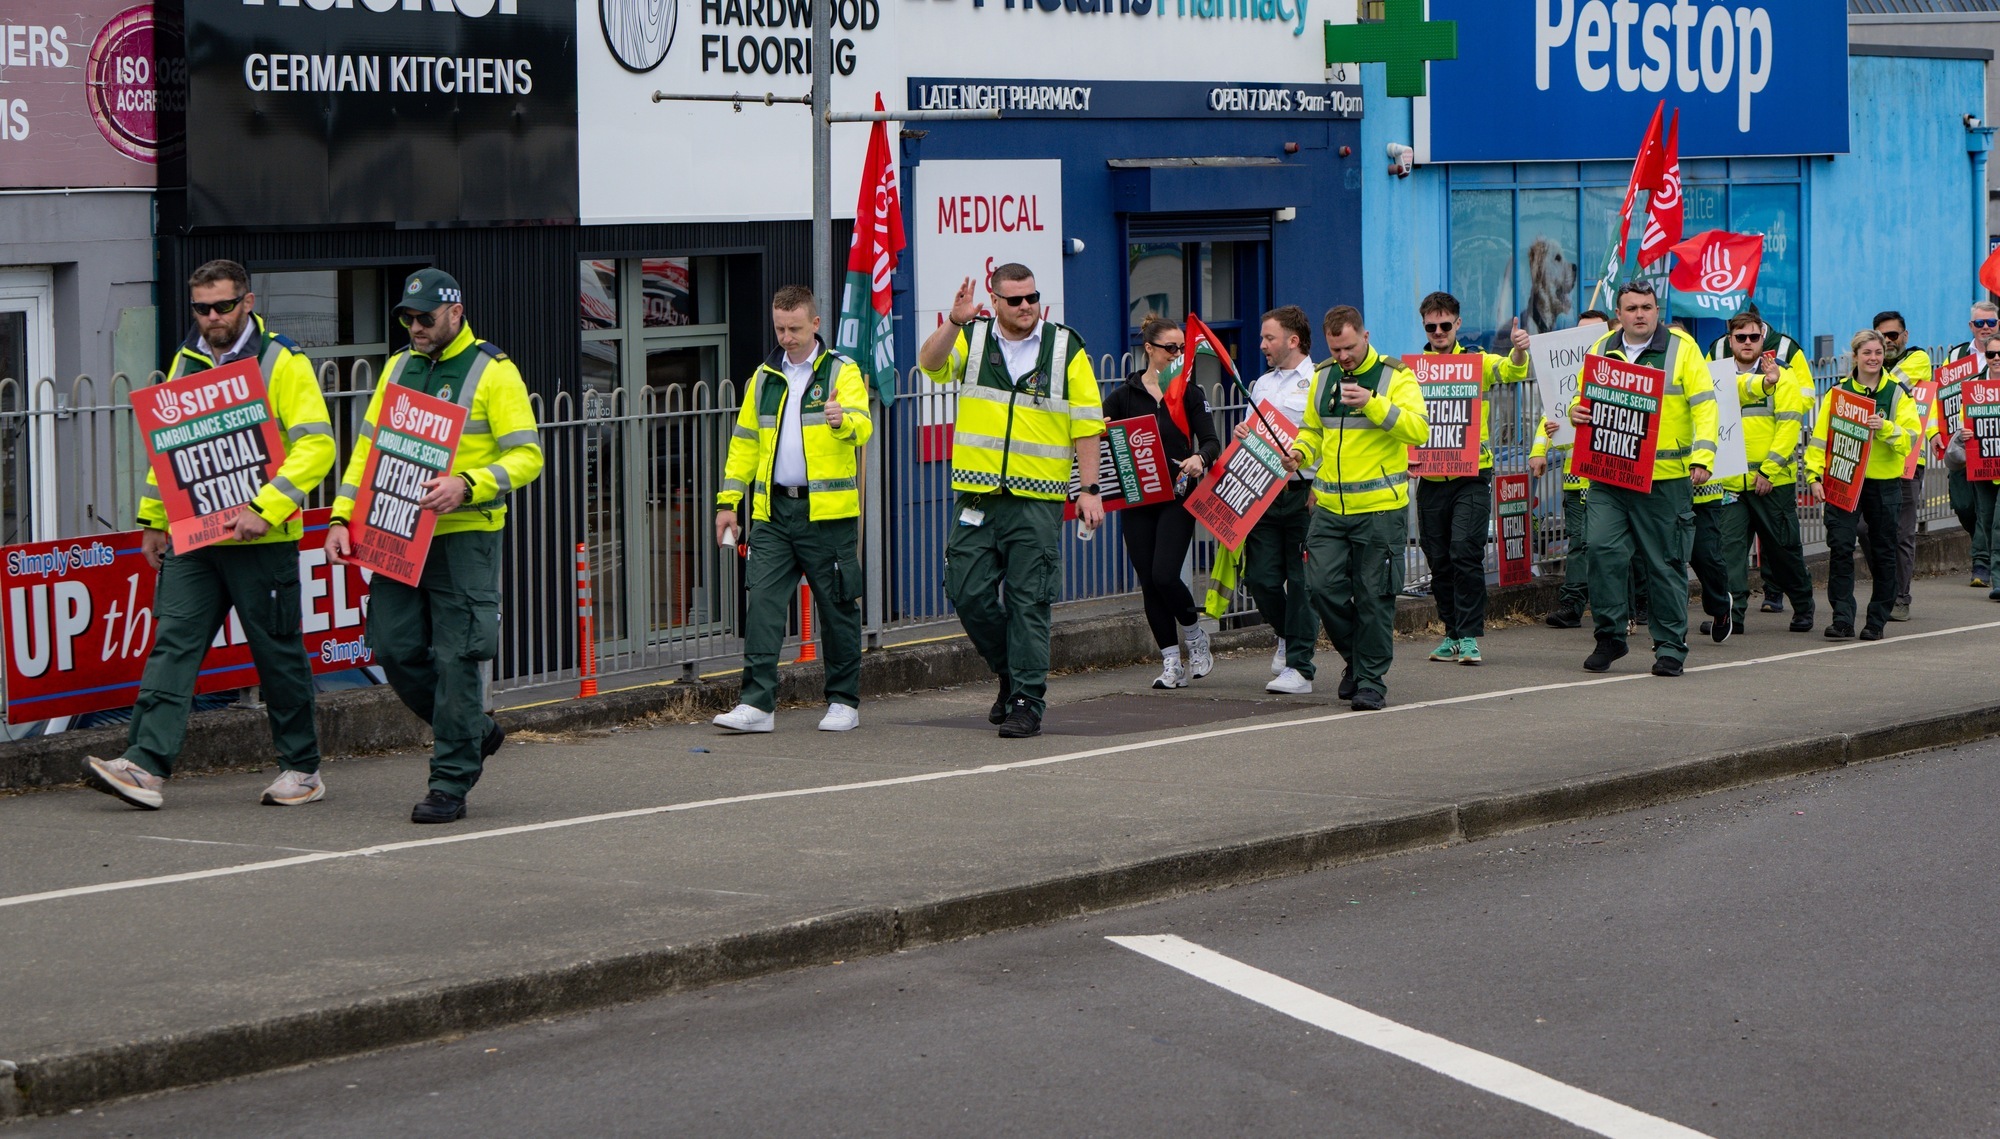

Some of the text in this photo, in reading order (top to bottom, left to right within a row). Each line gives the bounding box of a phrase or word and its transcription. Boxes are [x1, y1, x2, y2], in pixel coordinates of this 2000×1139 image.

[701, 0, 880, 30] HARDWOD
[0, 25, 69, 68] ERS
[702, 34, 857, 76] FLOORIG
[117, 56, 149, 84] ISO
[244, 53, 533, 95] GERMAN KITCHENS
[1535, 0, 1773, 133] Petstop
[919, 85, 1092, 110] LATE NIGHT PHARMACY
[1211, 88, 1249, 111] OPEN
[1249, 90, 1258, 110] 7
[1259, 90, 1291, 111] DAYS
[938, 195, 1044, 234] MEDICAL
[1550, 344, 1592, 369] HONK
[1949, 361, 1973, 380] SIPTU
[1430, 363, 1473, 380] SIPTU
[1559, 373, 1577, 395] FO
[1610, 368, 1653, 394] SIPTU
[180, 375, 249, 416] SIPTU
[1420, 385, 1478, 397] ULANCE SECTOR
[1586, 385, 1657, 412] AMBULANCE SECTOR
[405, 406, 453, 443] SIPTU
[1424, 399, 1468, 423] FICIAL
[1592, 402, 1645, 436] OFFICIAL
[1844, 403, 1868, 424] SIPTU
[154, 404, 267, 450] AMBULANCE SECTOR
[1419, 424, 1463, 448] TRIKE
[376, 430, 450, 467] AMBULANCE SECTOR
[1418, 450, 1462, 462] HSE NATIONAL
[1593, 427, 1638, 459] STRIKE
[1832, 432, 1862, 463] OFFICIAL
[174, 430, 265, 485] OFFICIAL
[1110, 428, 1140, 503] AMBULANCE SECTOR
[1135, 447, 1162, 493] SIPTU
[1449, 461, 1473, 472] SERVICE
[1591, 453, 1635, 473] HSE NATIONAL
[1829, 456, 1856, 483] STRIKE
[1228, 447, 1274, 497] OFFICIAL
[1579, 462, 1645, 487] AMBULANCE SERVICE
[194, 466, 261, 516] STRIKE
[1215, 472, 1256, 516] STRIKE
[1507, 482, 1525, 499] SIPTU
[202, 513, 221, 528] HSE
[369, 491, 420, 538] STRIKE
[1503, 515, 1525, 538] OFFICIAL
[188, 526, 234, 546] AMBULA
[1506, 538, 1524, 560] STRIKE
[8, 541, 115, 578] SimplySuits
[10, 579, 92, 678] UP
[102, 572, 152, 662] th
